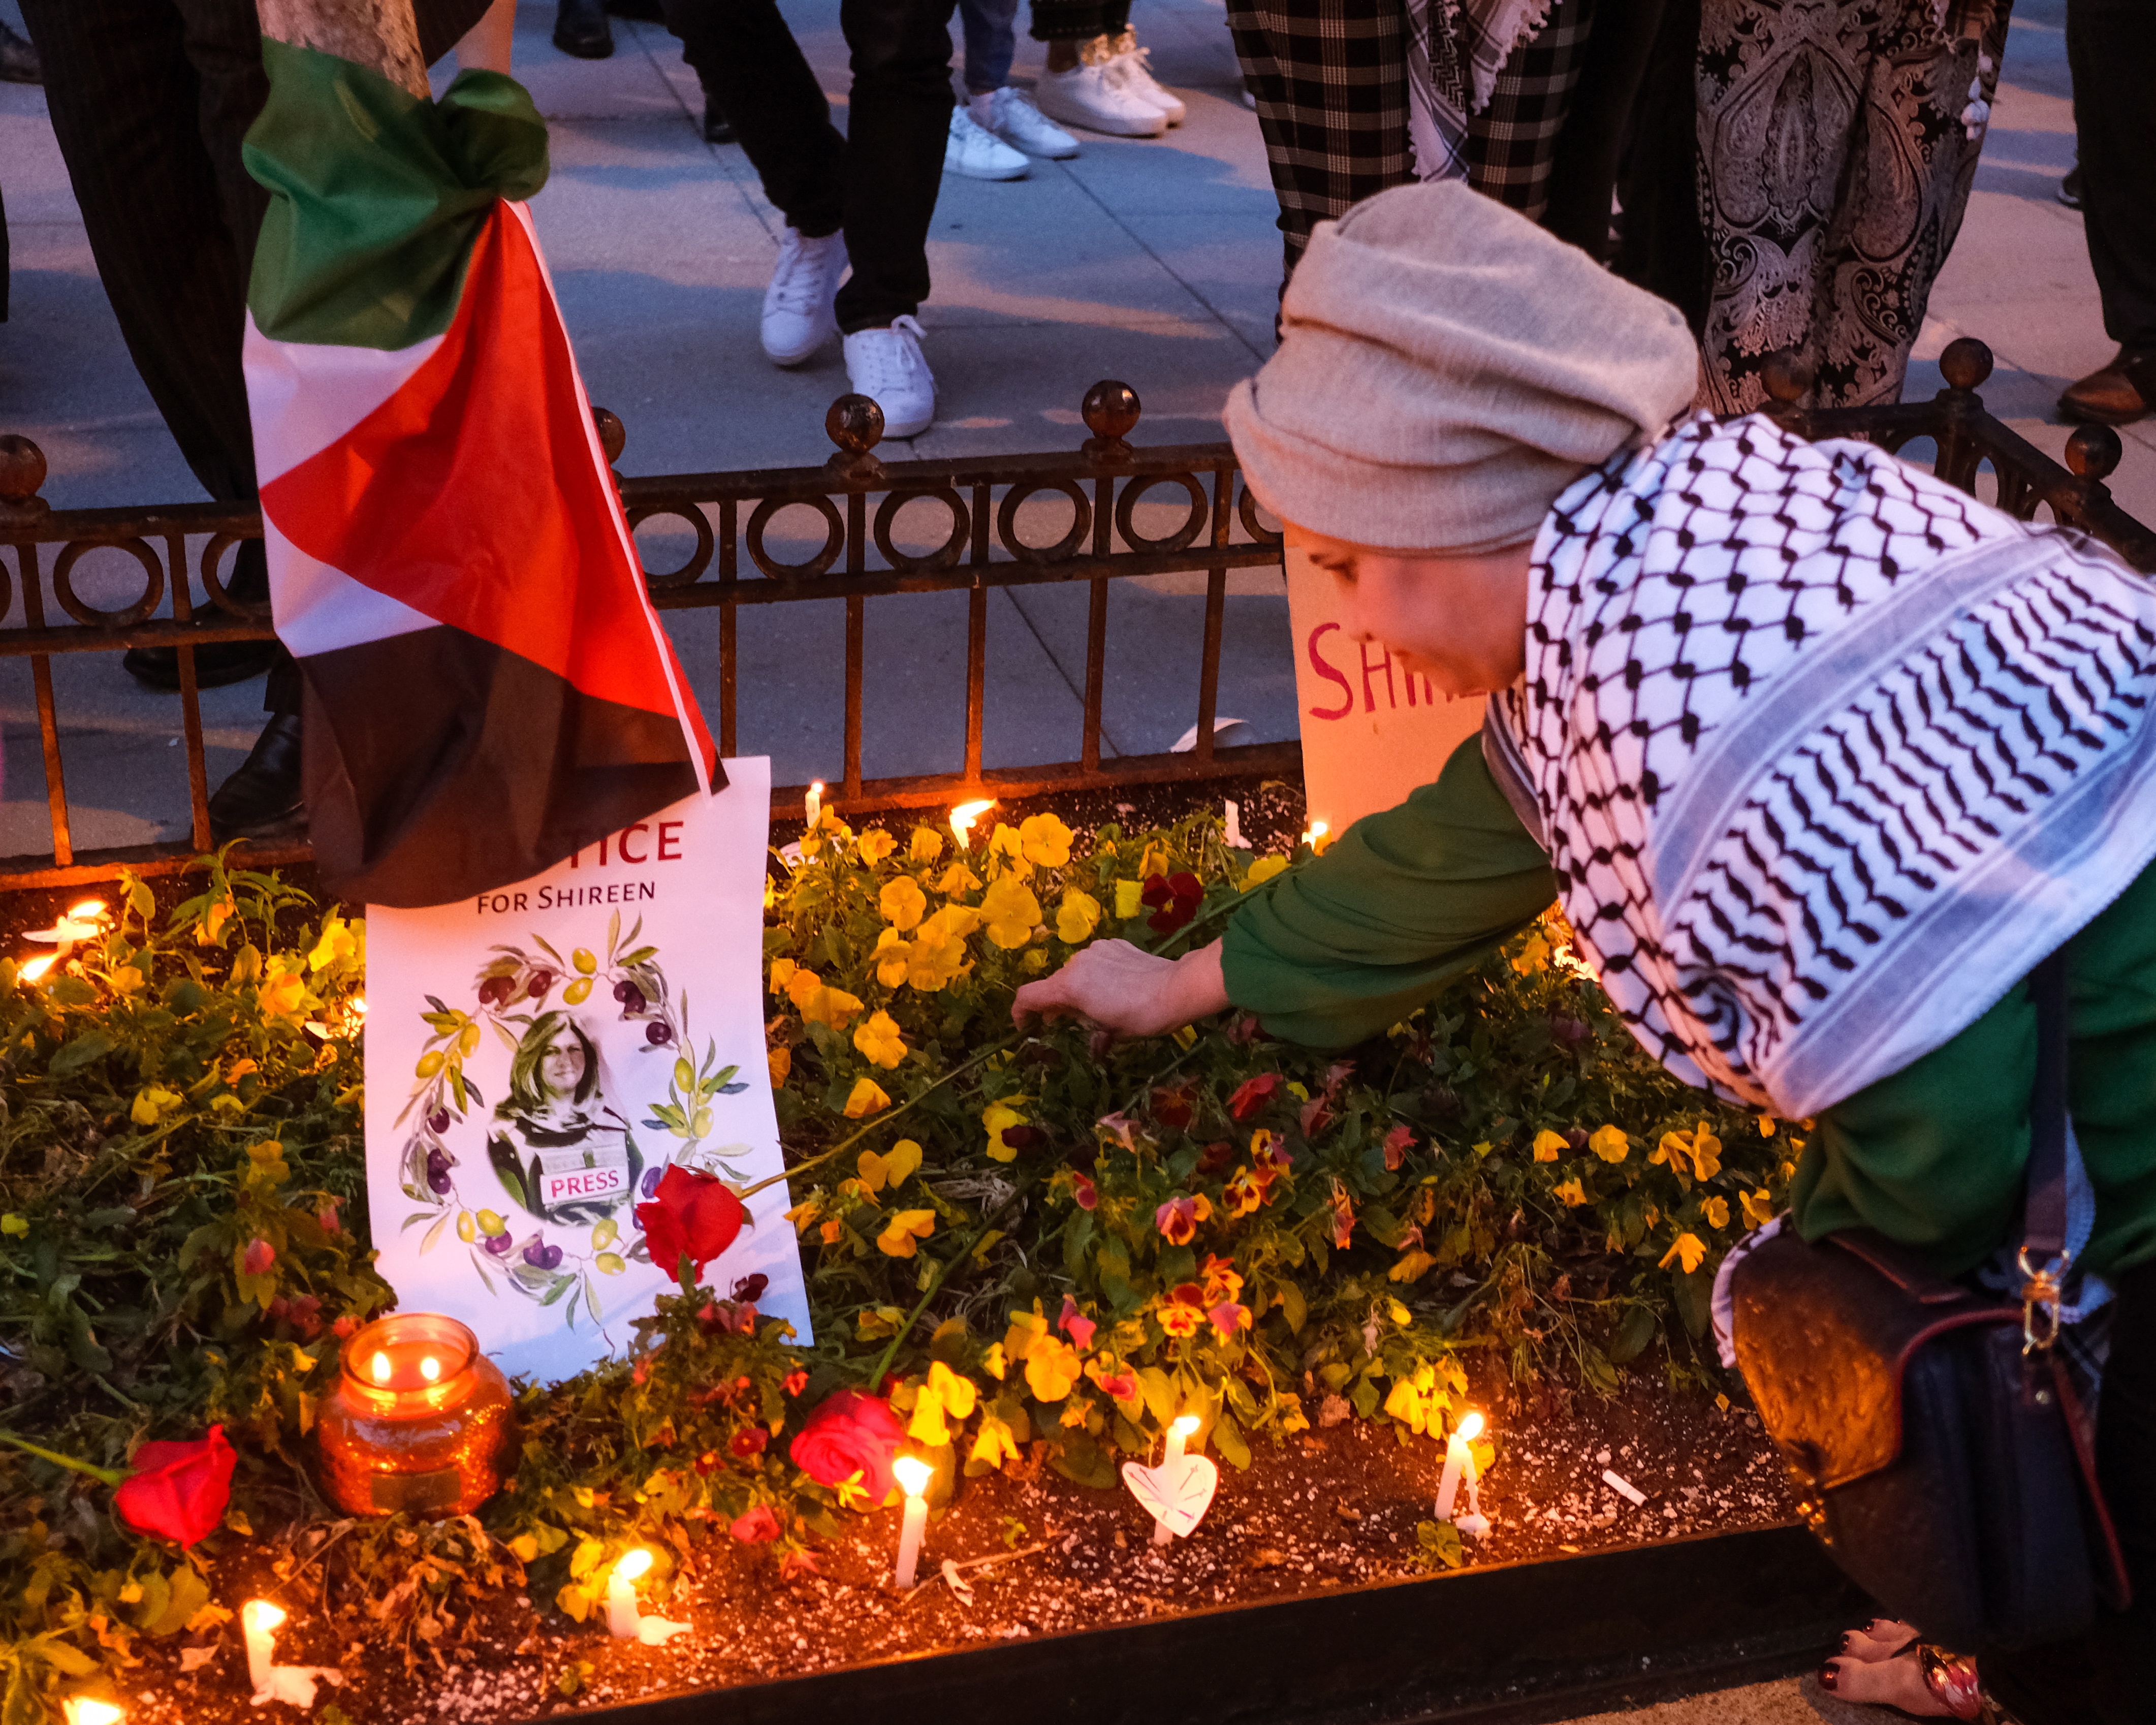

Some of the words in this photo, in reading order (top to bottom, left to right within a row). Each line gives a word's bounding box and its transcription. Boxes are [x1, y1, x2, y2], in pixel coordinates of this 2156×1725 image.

[477, 892, 528, 914] FOR
[537, 881, 655, 908] SHIREEN
[551, 1170, 619, 1198] PRESS
